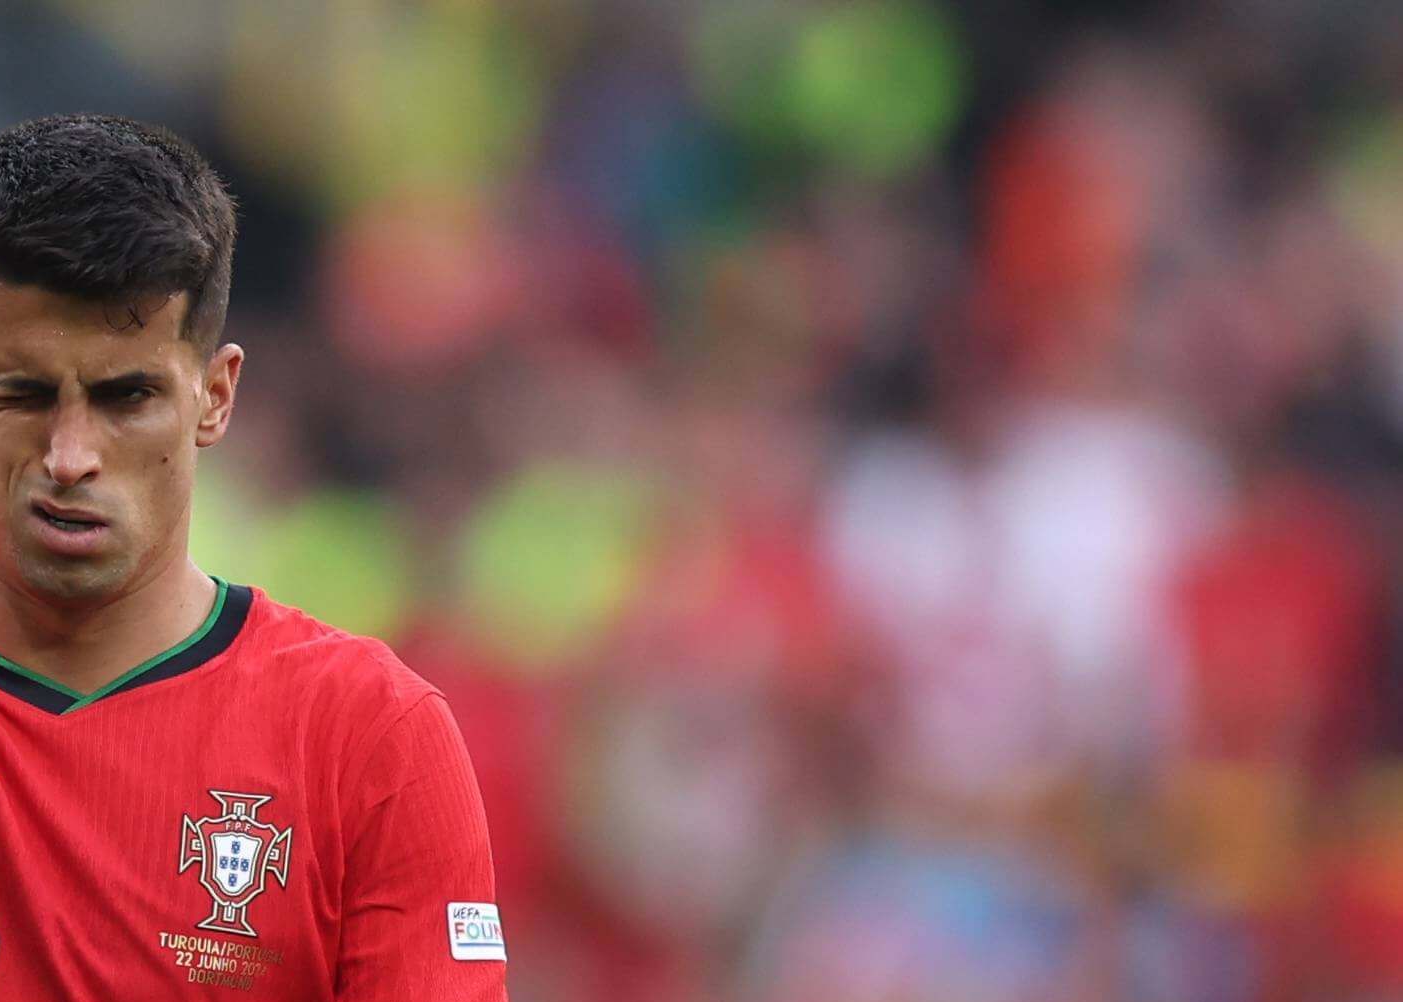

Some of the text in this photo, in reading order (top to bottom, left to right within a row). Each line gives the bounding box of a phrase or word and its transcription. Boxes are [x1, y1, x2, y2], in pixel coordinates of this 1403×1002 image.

[453, 907, 480, 919] UEFA
[175, 951, 194, 967] 22
[196, 955, 237, 974] JUNHO
